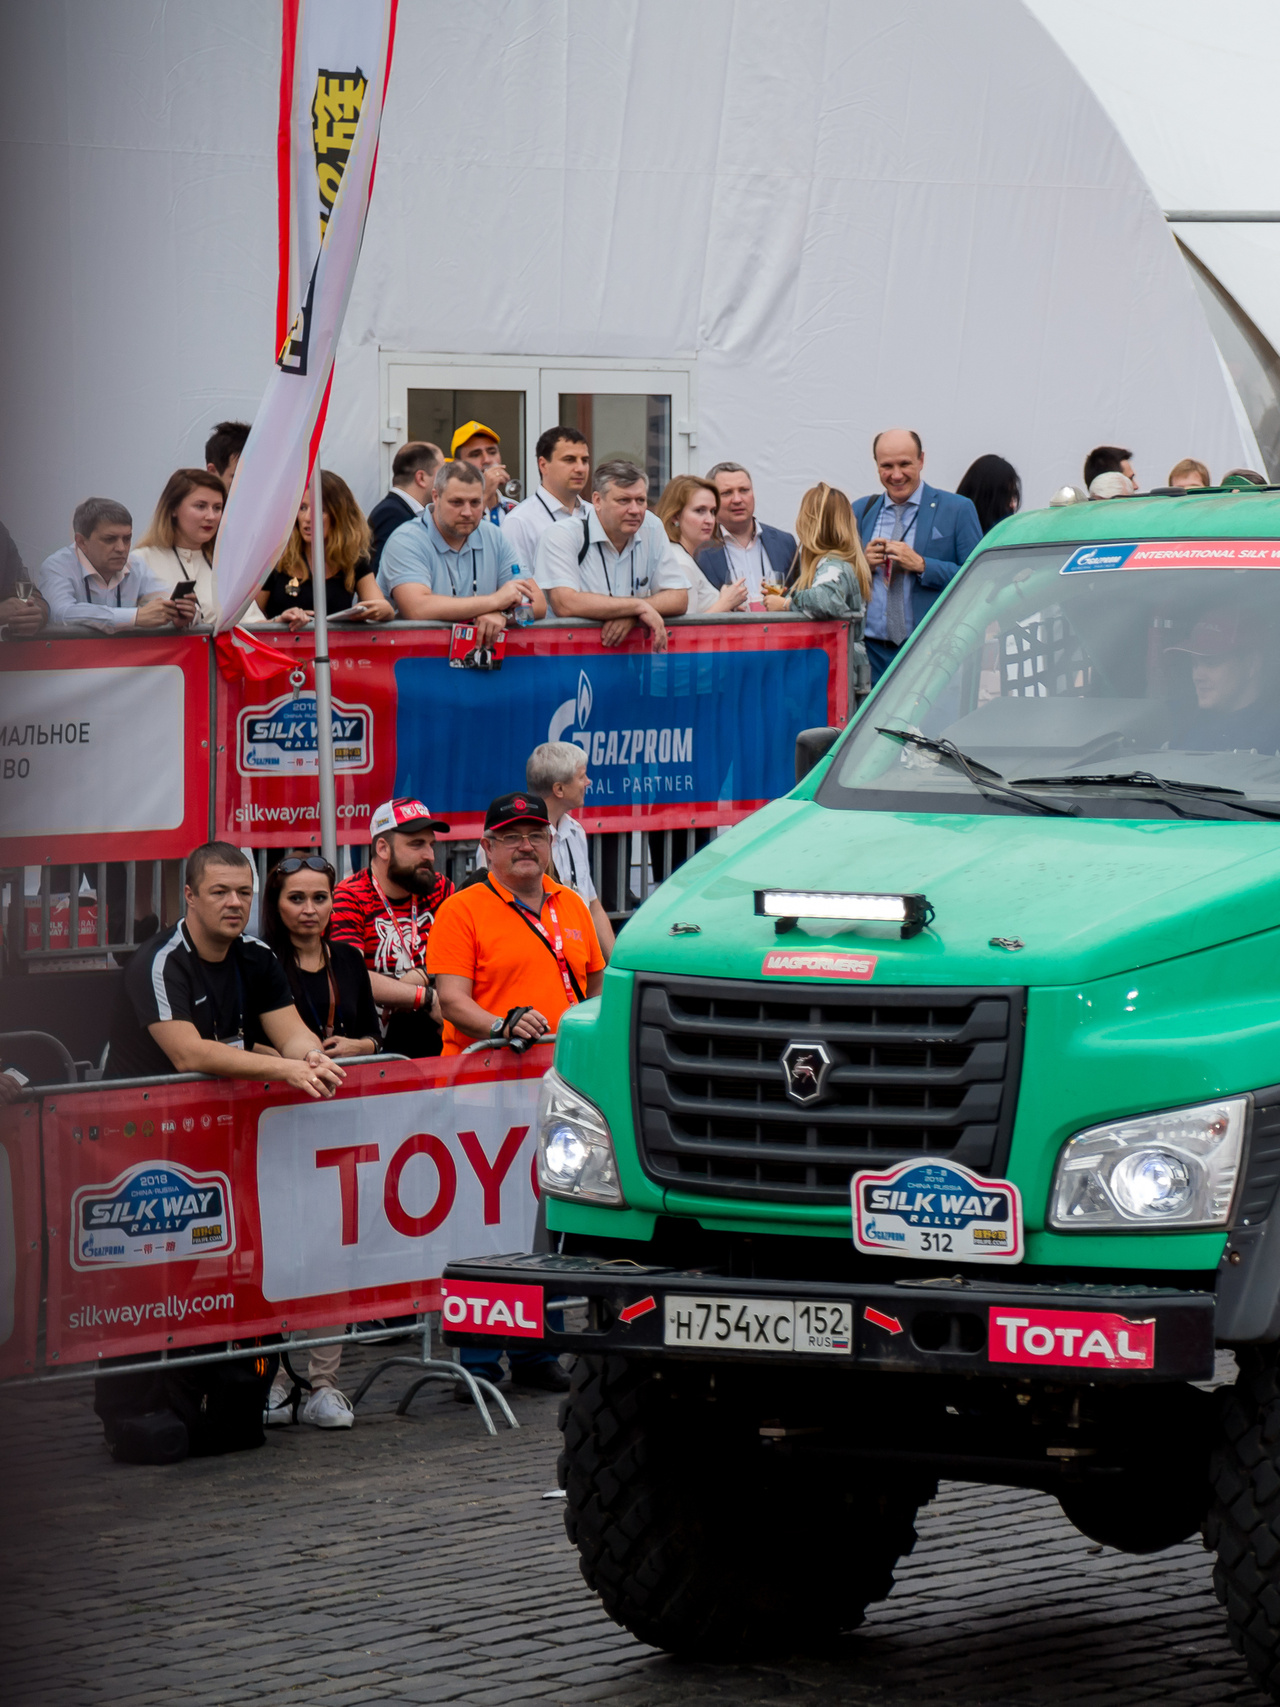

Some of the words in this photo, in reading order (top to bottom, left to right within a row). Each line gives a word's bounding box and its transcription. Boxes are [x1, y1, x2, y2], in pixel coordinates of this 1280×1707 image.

[1134, 549, 1235, 560] INTERNATIONAL
[1237, 549, 1270, 559] SILK
[252, 722, 306, 739] SILK
[591, 727, 693, 766] GAZPROM
[623, 775, 694, 793] PARTNER
[767, 956, 870, 973] MAGFORMERS
[162, 1122, 176, 1131] FIA
[140, 1174, 168, 1187] 2018
[315, 1125, 540, 1246] TOY
[89, 1199, 159, 1225] SILK
[162, 1192, 214, 1217] WAY
[870, 1190, 936, 1213] SILK
[940, 1194, 1002, 1216] WAY
[131, 1219, 182, 1233] RALLY
[909, 1214, 962, 1226] RALLY
[920, 1231, 953, 1252] 312
[69, 1293, 234, 1329] silkwayrally.com
[441, 1288, 538, 1330] OTAL
[799, 1305, 844, 1336] 152
[808, 1335, 831, 1348] RUS
[996, 1316, 1146, 1360] TOTAL
